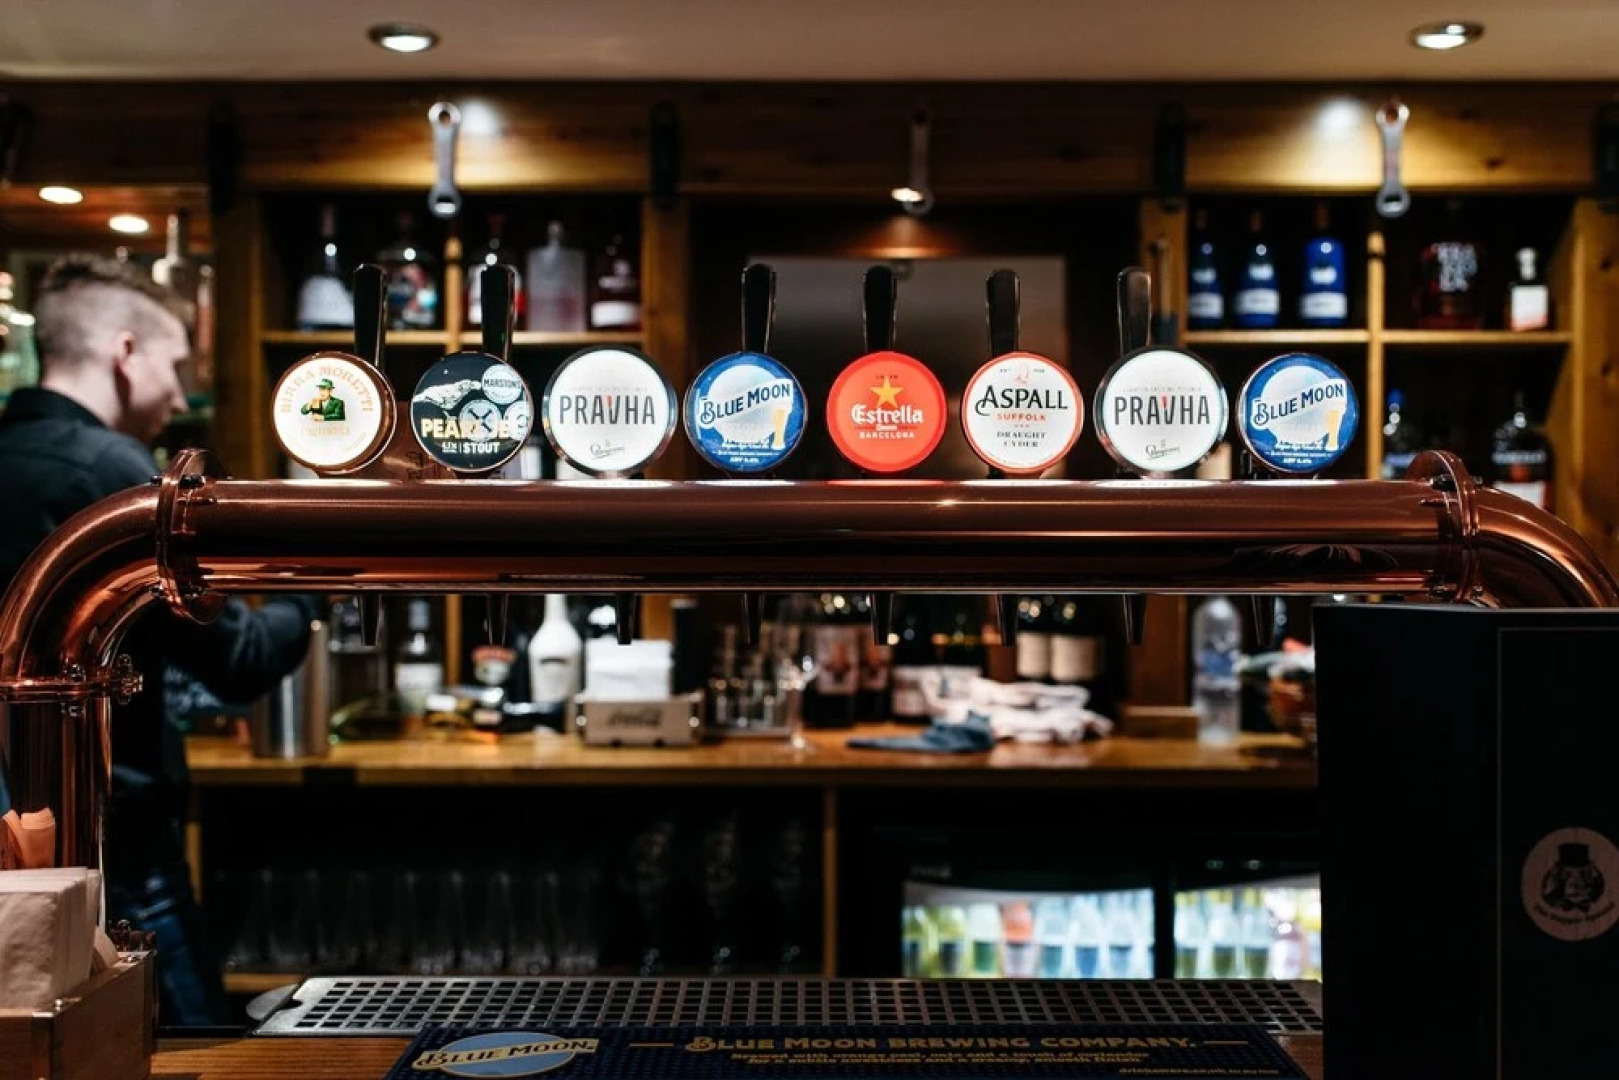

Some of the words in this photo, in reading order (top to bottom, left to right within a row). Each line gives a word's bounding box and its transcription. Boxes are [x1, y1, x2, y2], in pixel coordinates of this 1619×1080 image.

[319, 366, 374, 412] MORETTI
[559, 394, 656, 425] PRAVHA
[700, 396, 745, 425] BLUE
[747, 383, 792, 409] MOON
[974, 384, 1069, 417] ASPALL
[1114, 394, 1210, 425] PRAVHA
[1253, 398, 1298, 426] BLUE
[1301, 384, 1345, 409] MOON
[850, 403, 924, 425] Estrella
[997, 413, 1047, 422] SUFFOLK
[859, 431, 915, 440] BARCELONA
[997, 431, 1047, 439] DRAUGHT
[1003, 440, 1039, 448] CYDER
[462, 441, 501, 454] STOUT
[684, 1036, 775, 1052] BLUE
[784, 1037, 877, 1049] MOON
[888, 1037, 1031, 1049] BREWING
[417, 1049, 500, 1067] BLUE
